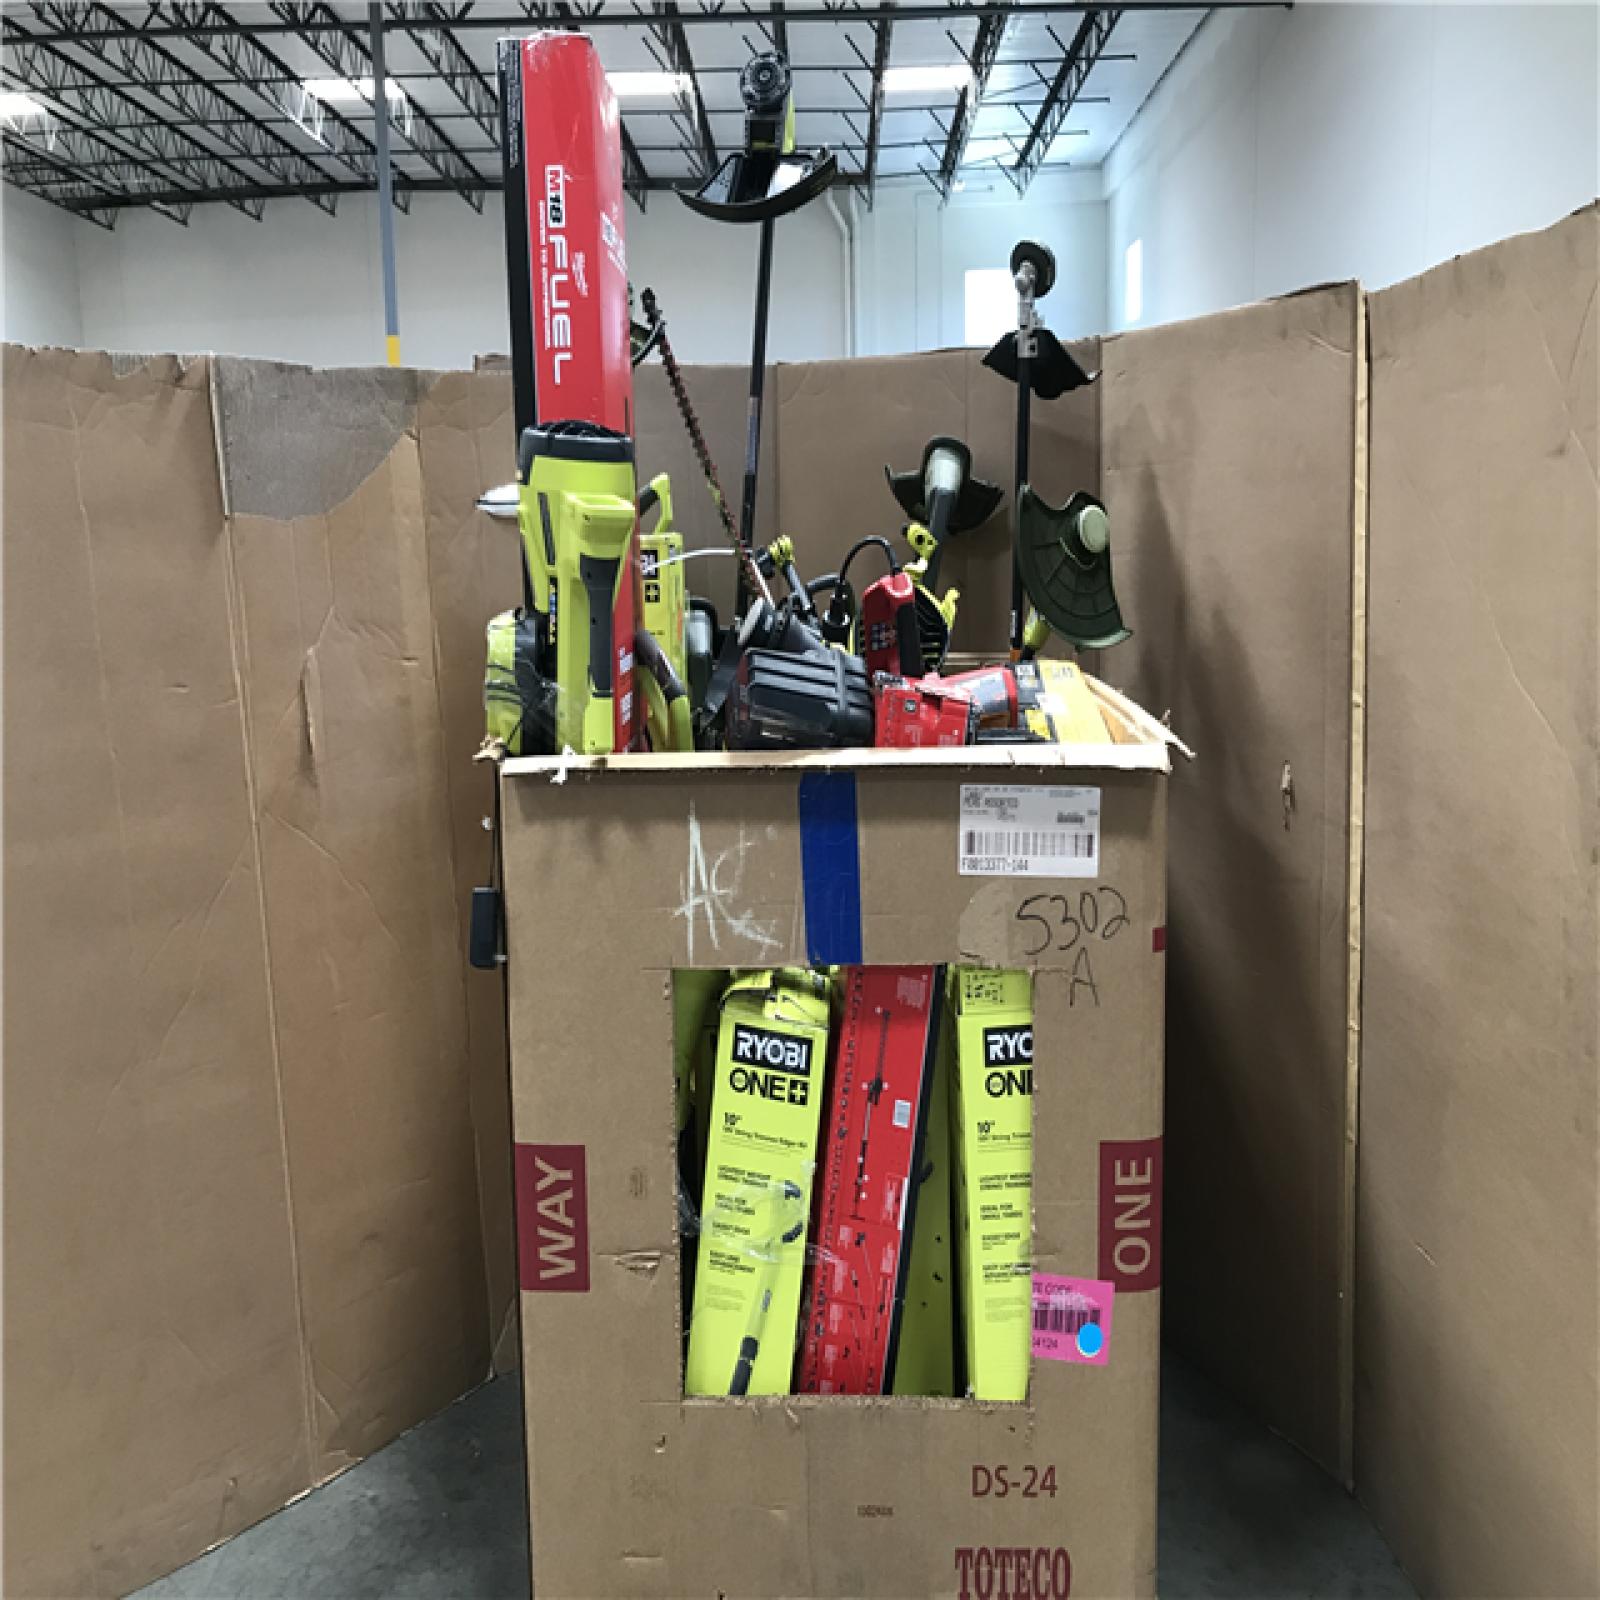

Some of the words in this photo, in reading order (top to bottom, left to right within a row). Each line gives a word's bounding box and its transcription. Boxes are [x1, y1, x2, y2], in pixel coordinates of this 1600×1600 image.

[547, 167, 566, 226] M18
[548, 234, 572, 386] FUEL
[1015, 885, 1131, 955] 5302
[735, 1030, 809, 1071] RYOBI
[985, 1069, 1033, 1098] ON
[533, 1155, 577, 1281] WAY
[1112, 1156, 1152, 1275] ONE
[971, 1464, 1058, 1499] DS-24
[954, 1545, 1072, 1600] TOTECO
